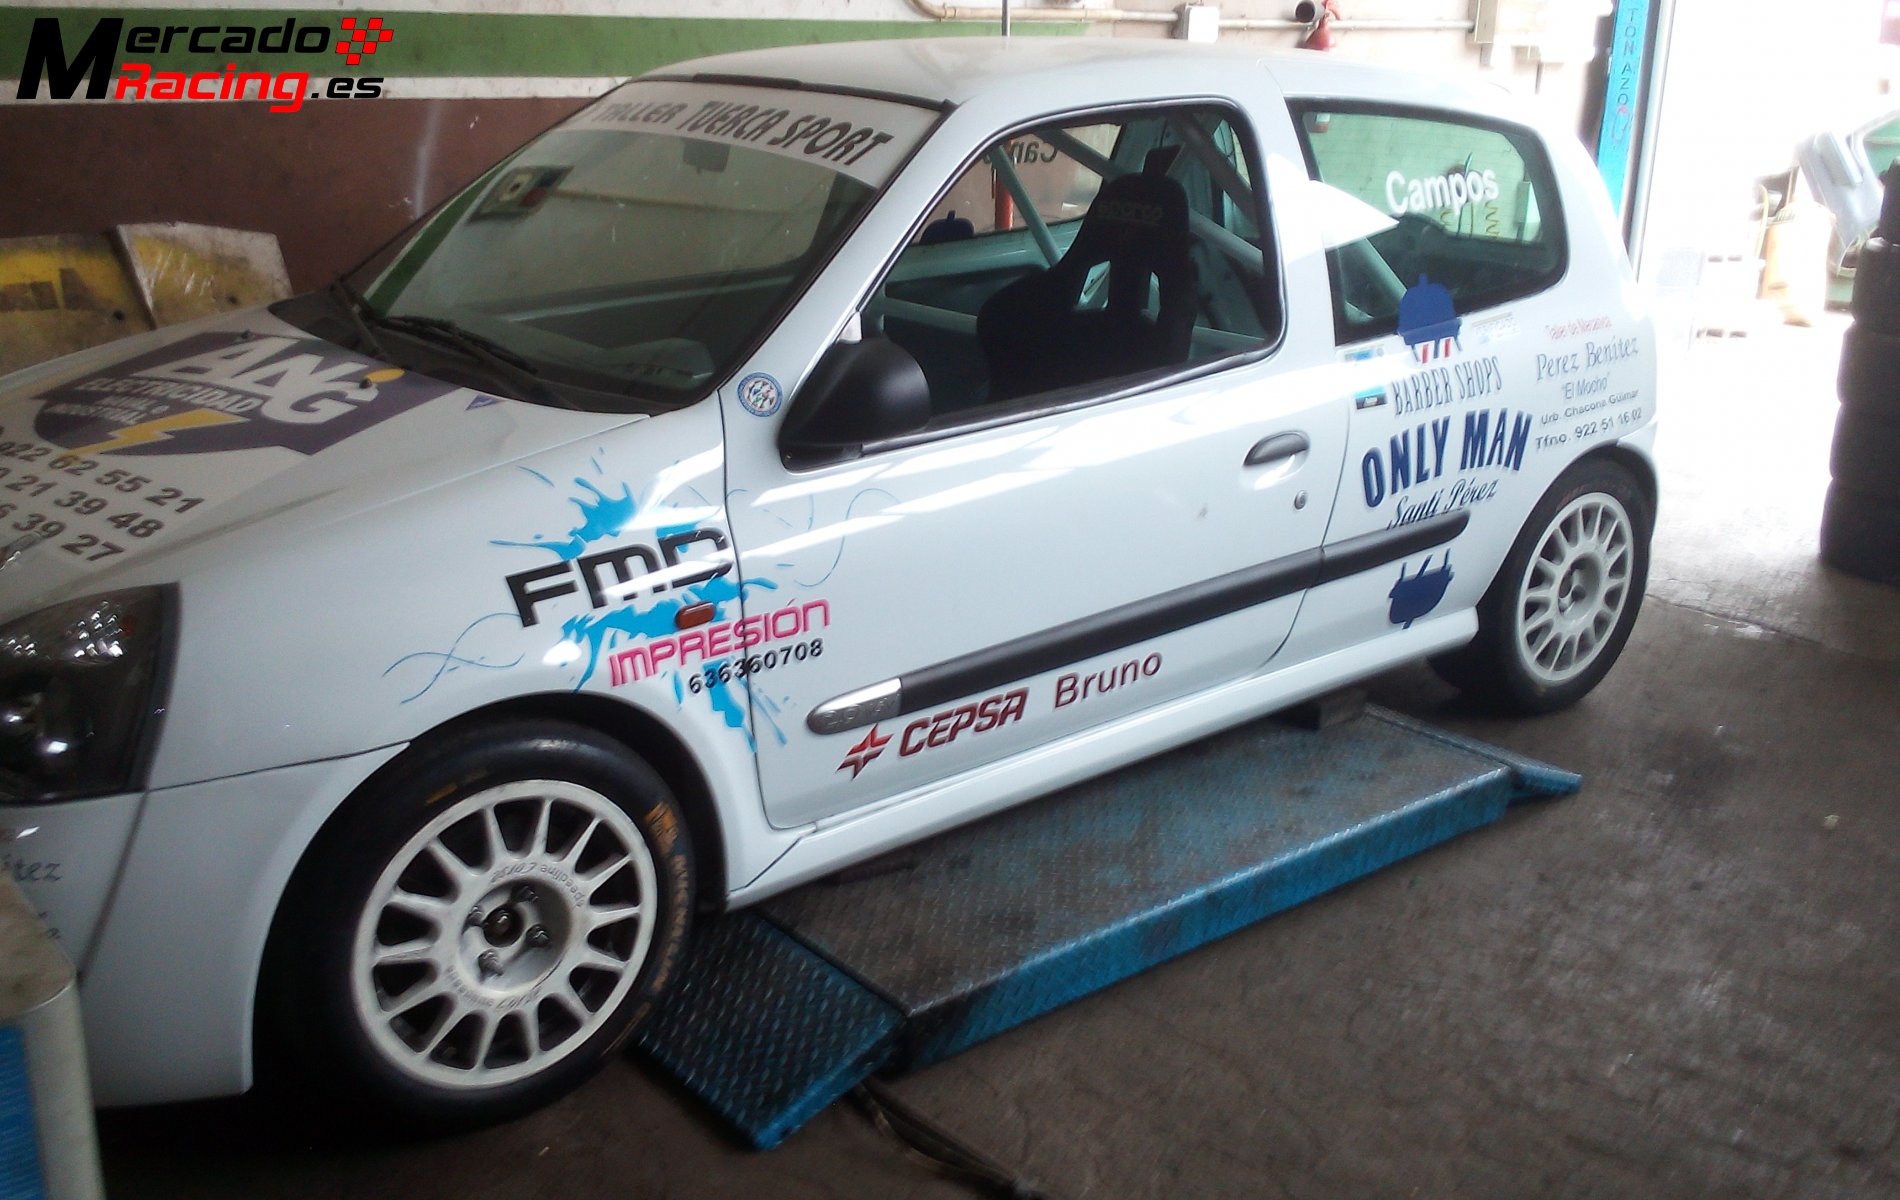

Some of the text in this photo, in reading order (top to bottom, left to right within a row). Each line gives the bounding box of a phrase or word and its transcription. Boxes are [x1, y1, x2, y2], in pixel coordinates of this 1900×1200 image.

[594, 100, 896, 166] TALLER TUERCA SPORT
[1385, 169, 1499, 217] Campos
[128, 336, 379, 425] ANG
[1391, 355, 1502, 416] BARBER SHOPS
[1535, 353, 1579, 381] Perez
[1575, 421, 1597, 439] 922
[1601, 417, 1614, 432] 51
[1618, 413, 1630, 424] 16
[48, 454, 100, 476] 62
[95, 469, 152, 493] 55
[145, 487, 205, 514] 21
[1362, 408, 1533, 508] ONLY MAN
[5, 475, 166, 538] 21 39 48
[1444, 477, 1499, 513] Pérez
[13, 513, 67, 539] 39
[61, 533, 127, 561] 27
[505, 527, 735, 628] FMD
[609, 598, 830, 688] IMPRESIÓN
[688, 638, 824, 694] 636360708
[898, 651, 1164, 758] CEPSA Bruno
